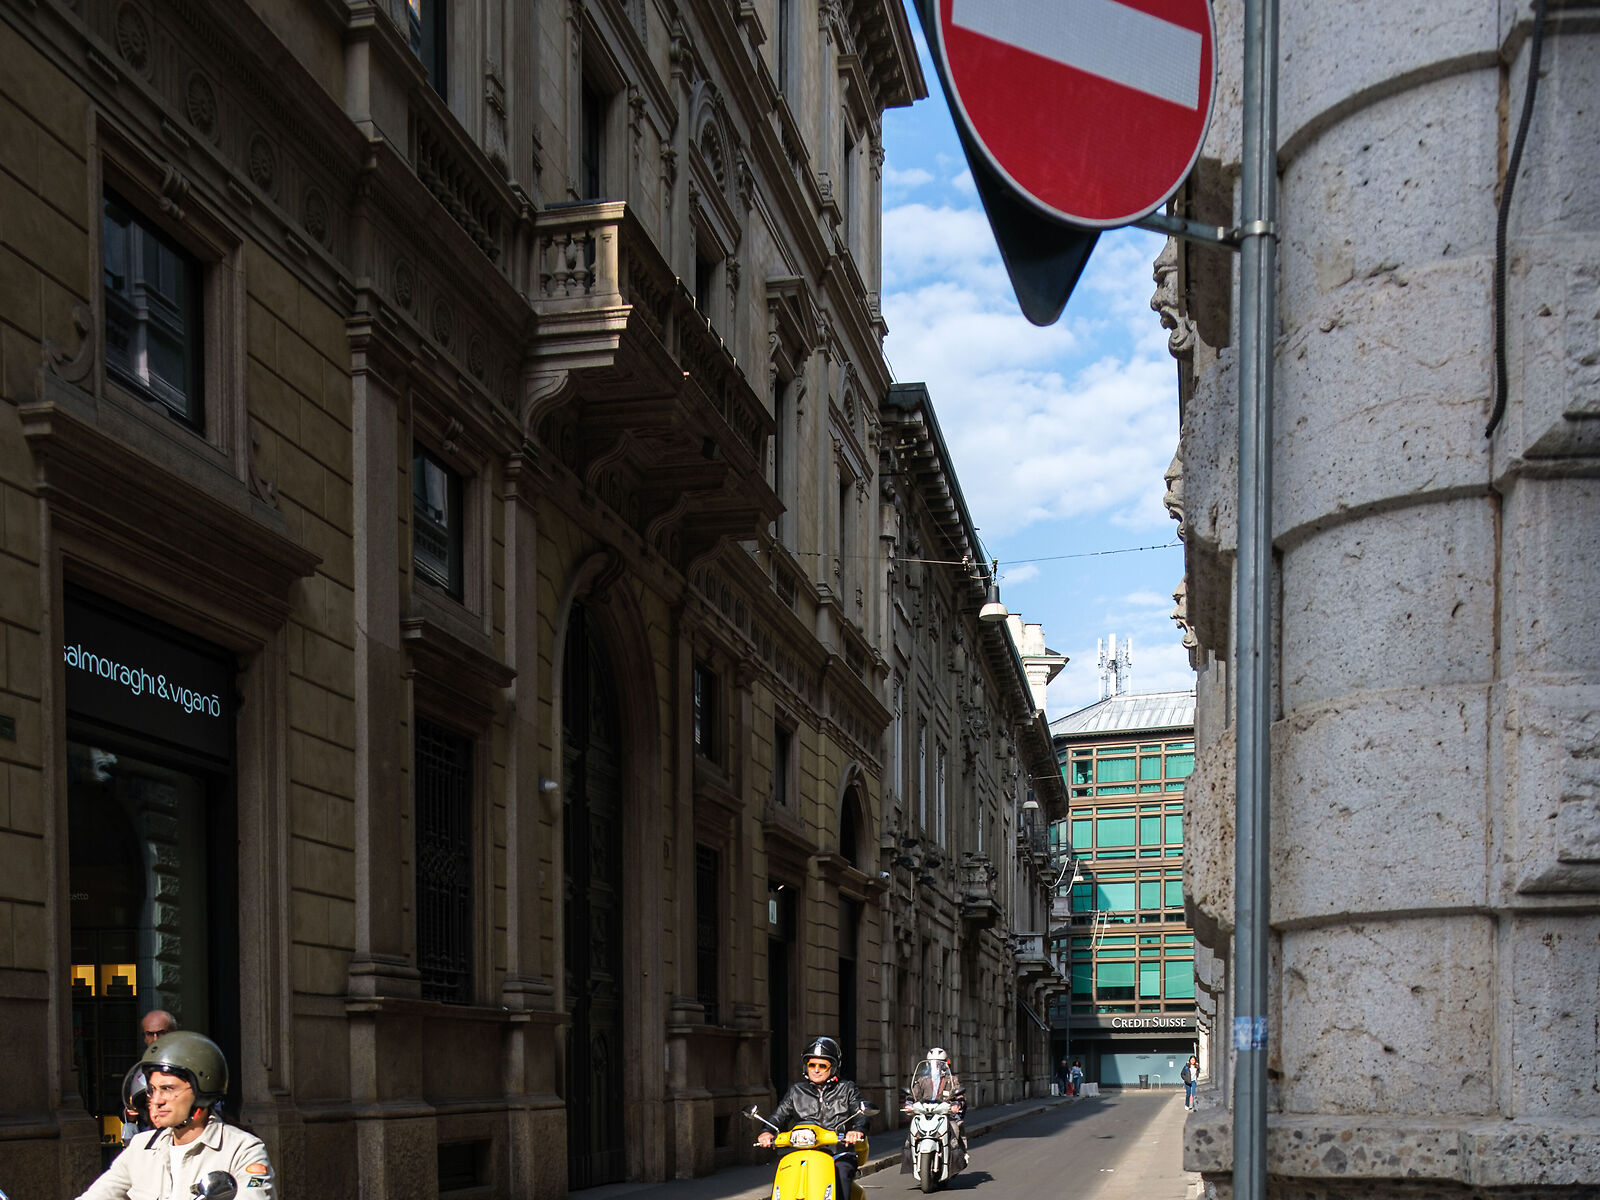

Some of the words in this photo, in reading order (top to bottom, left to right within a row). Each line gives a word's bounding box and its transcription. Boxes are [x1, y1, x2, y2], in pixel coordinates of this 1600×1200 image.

[157, 674, 170, 699] &
[1112, 1017, 1151, 1028] CREDIT
[1152, 1017, 1187, 1027] SUISSE
